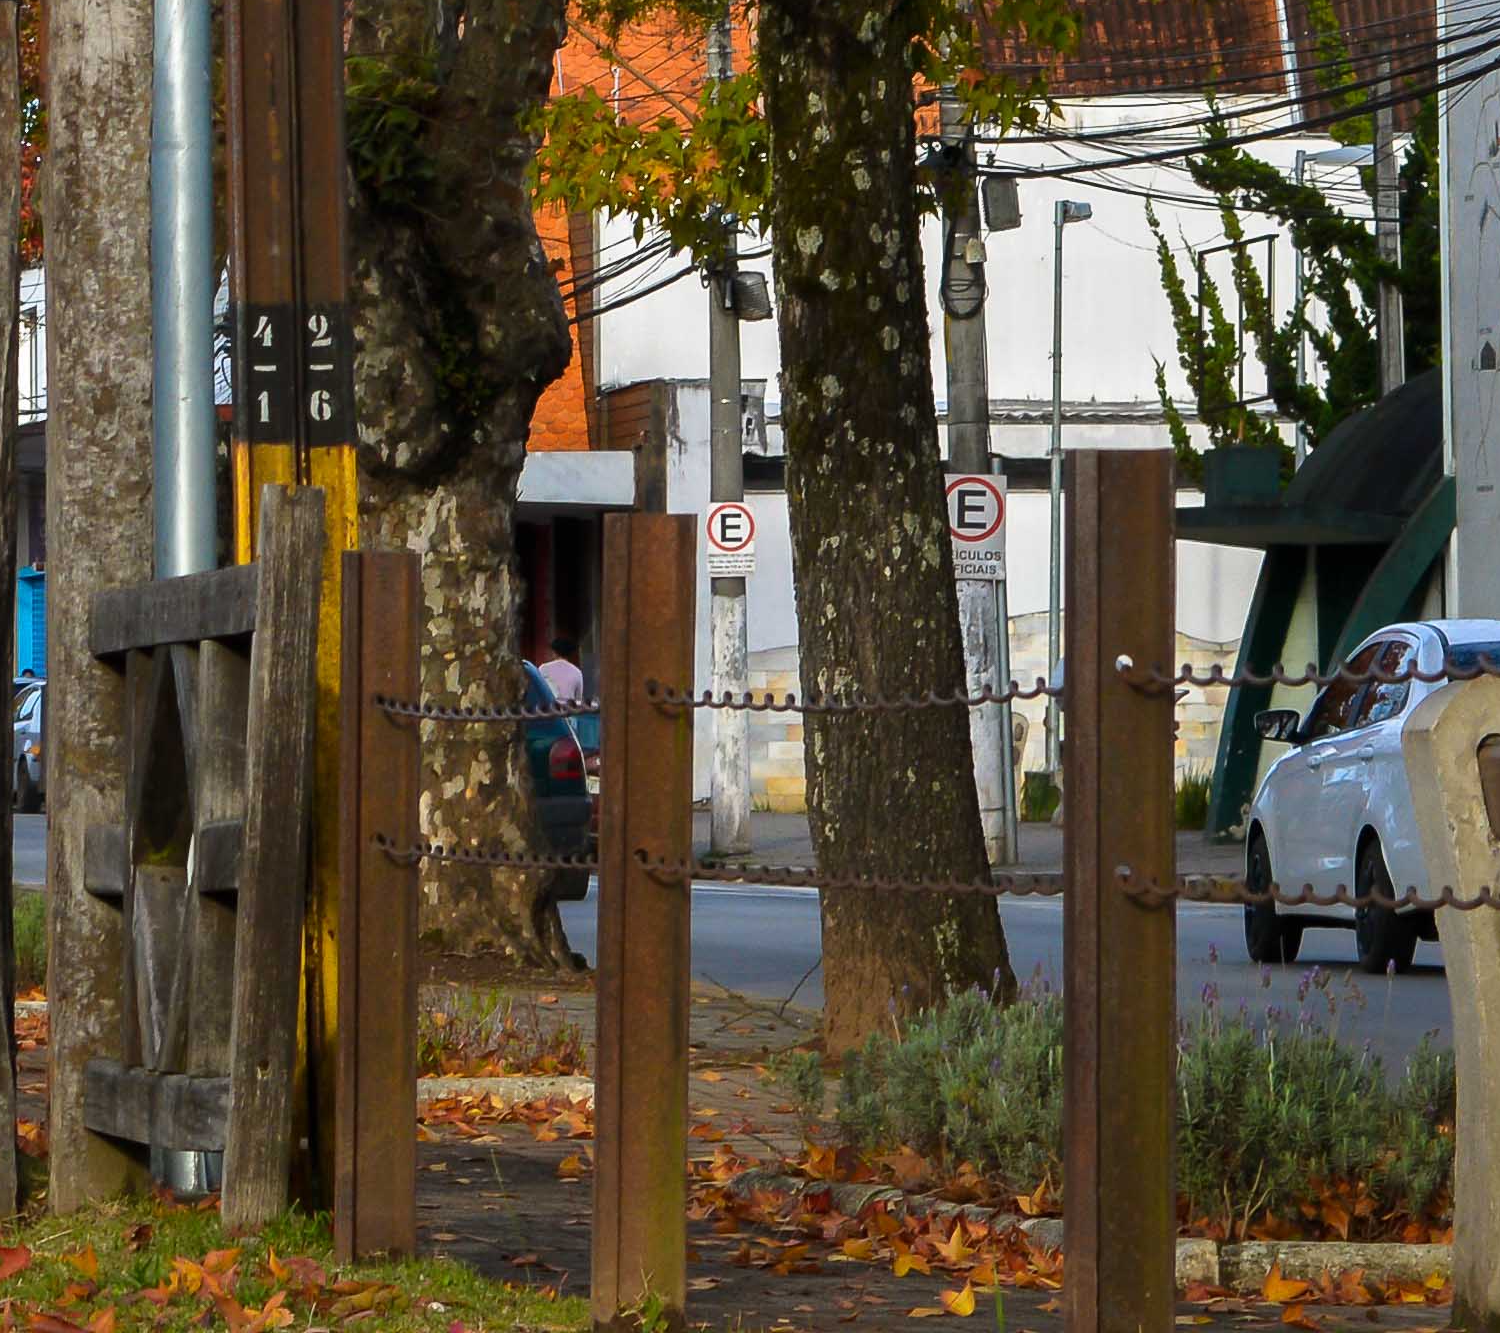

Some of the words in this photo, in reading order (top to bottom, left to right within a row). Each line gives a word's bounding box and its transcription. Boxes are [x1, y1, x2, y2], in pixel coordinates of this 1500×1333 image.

[253, 316, 272, 346] 4
[308, 315, 332, 347] 2
[258, 391, 270, 423] 1
[310, 390, 332, 421] 6
[957, 489, 987, 529] E
[720, 513, 742, 542] E
[953, 563, 997, 575] FICIAIS
